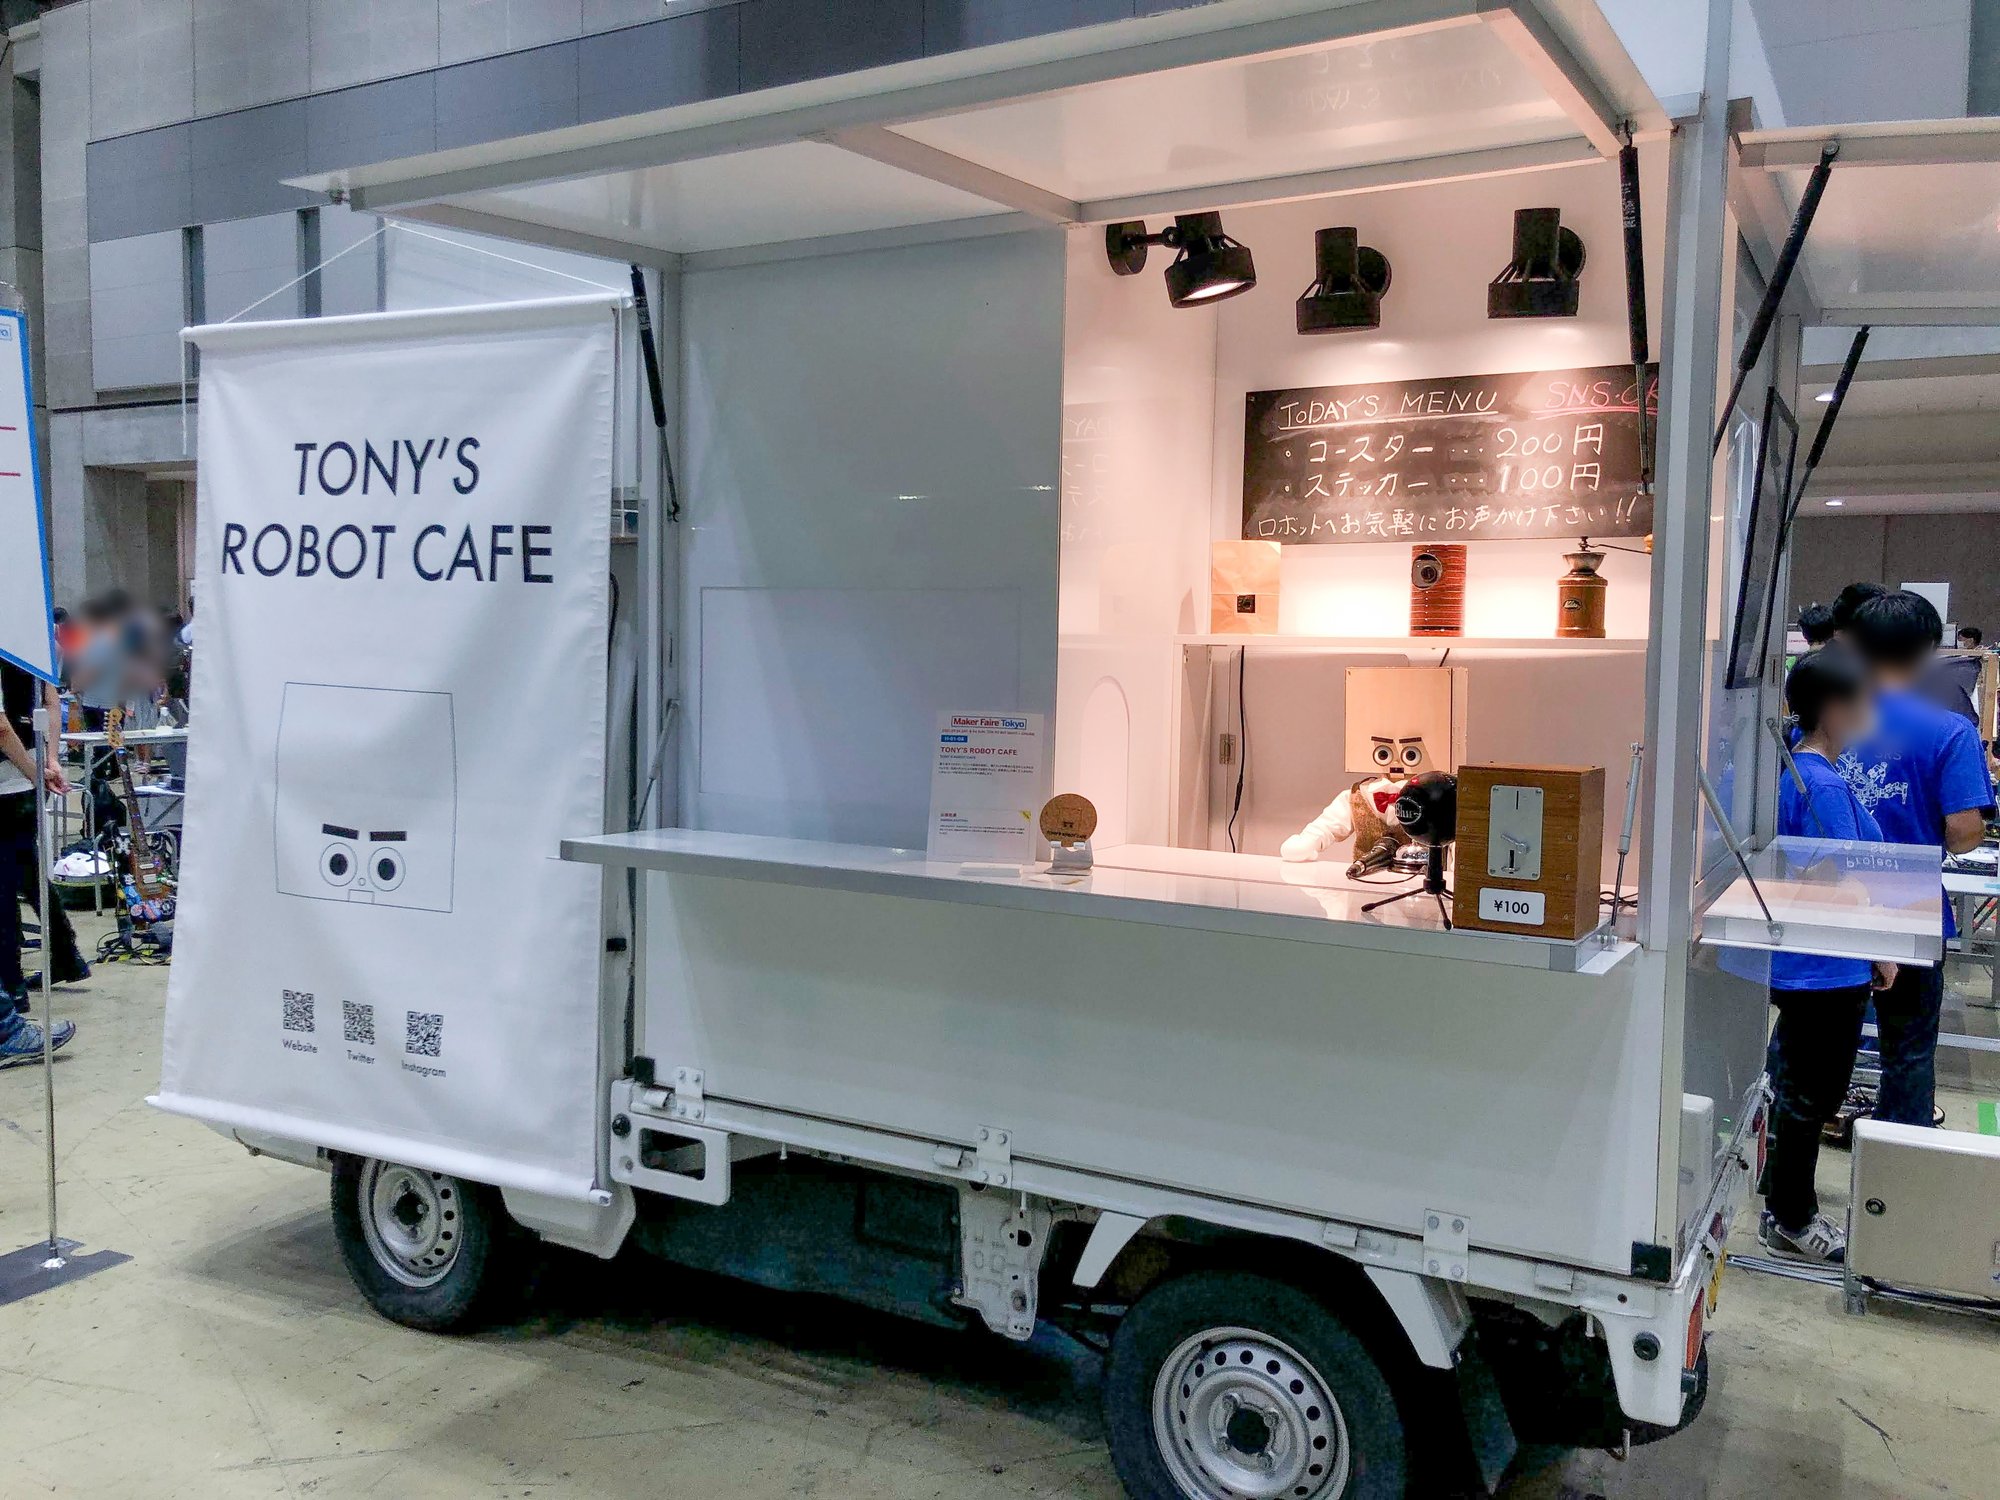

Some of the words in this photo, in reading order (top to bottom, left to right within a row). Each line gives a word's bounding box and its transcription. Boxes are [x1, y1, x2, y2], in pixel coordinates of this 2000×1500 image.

[1399, 389, 1498, 414] MENU
[293, 436, 481, 496] TONY'S
[222, 522, 396, 579] ROBOT
[412, 522, 554, 584] CAFE
[953, 717, 979, 726] Maker
[980, 718, 1000, 727] Faire
[1001, 719, 1025, 730] Tokyo
[940, 746, 968, 754] TONY'S
[1493, 899, 1531, 915] ¥100
[282, 1037, 318, 1054] Website
[346, 1049, 376, 1065] Twitter
[401, 1059, 447, 1078] Instagram
